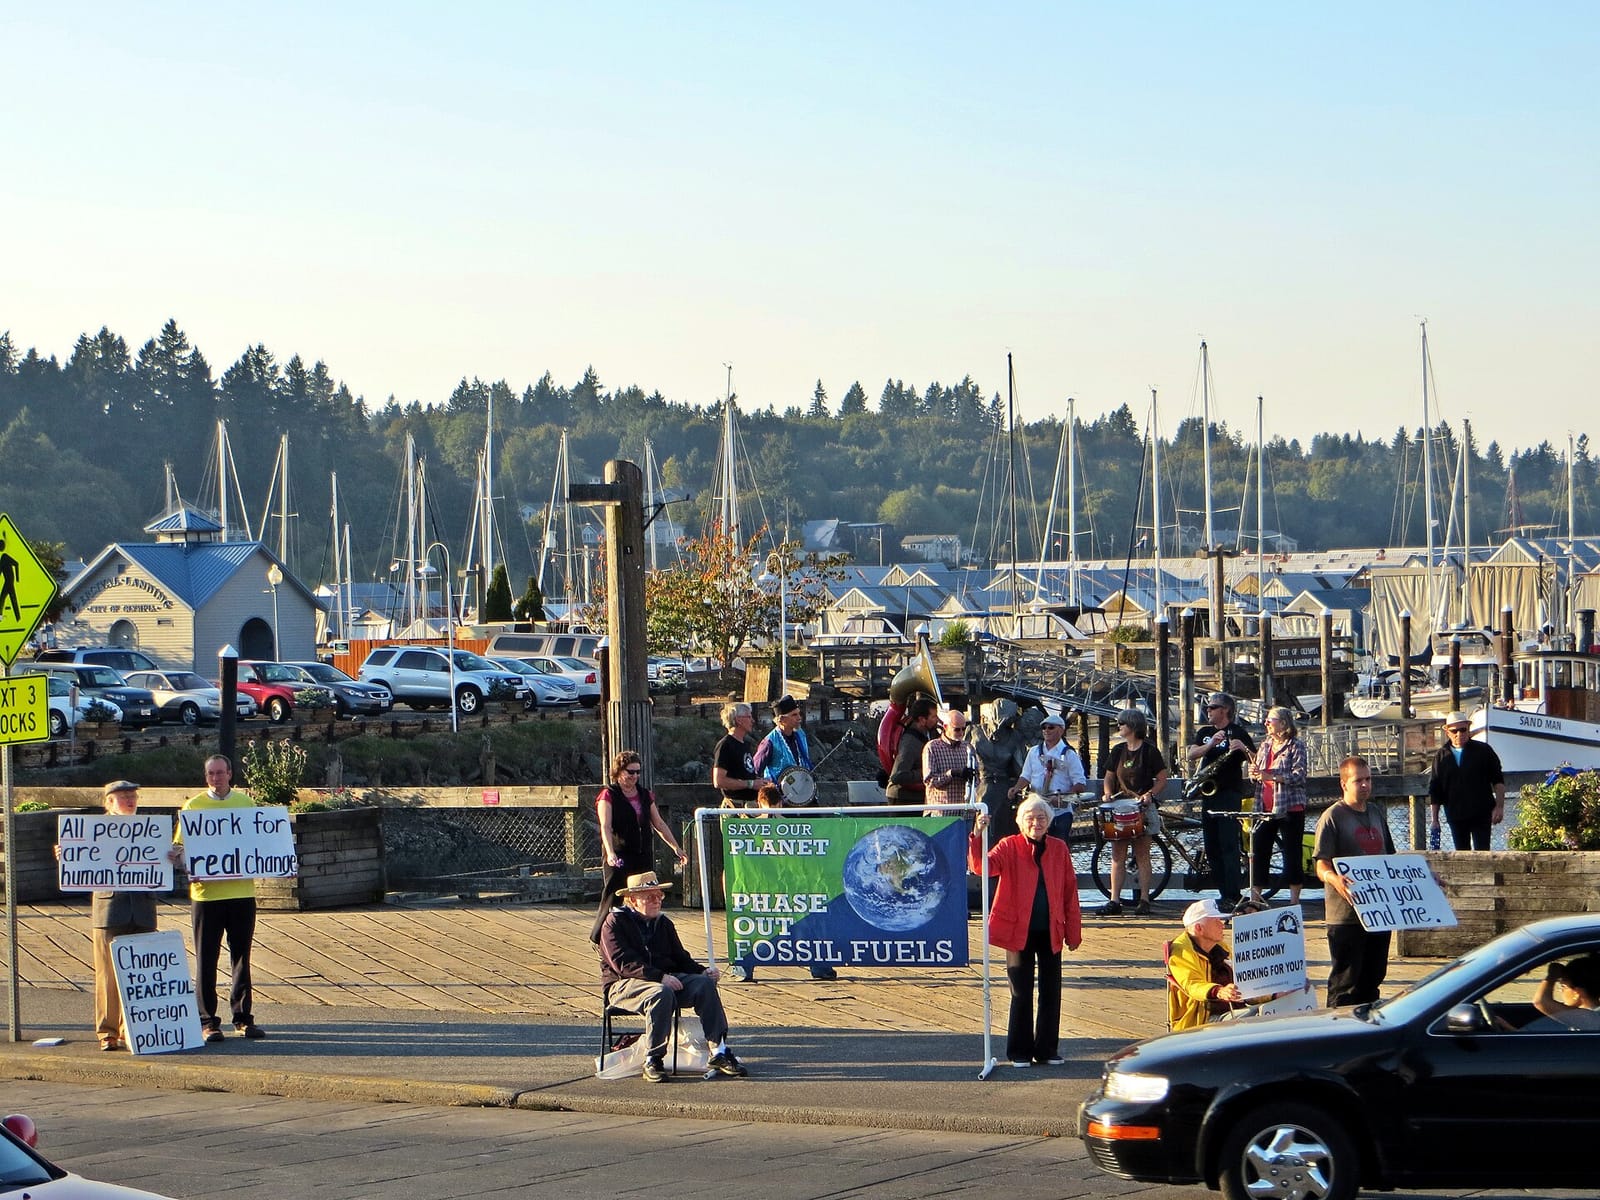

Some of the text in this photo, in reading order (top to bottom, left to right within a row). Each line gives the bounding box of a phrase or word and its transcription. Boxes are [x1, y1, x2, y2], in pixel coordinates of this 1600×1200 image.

[1, 685, 36, 708] XT 3
[1, 712, 36, 735] OCKS
[1519, 715, 1562, 731] SAND MAN
[61, 817, 162, 843] All people
[182, 811, 286, 837] Work for
[728, 823, 812, 836] SAVE OUR
[63, 845, 159, 863] are one
[729, 838, 829, 855] PLANET
[190, 848, 297, 876] real change
[1337, 860, 1426, 883] Peace begins
[61, 864, 164, 889] human family
[731, 893, 828, 913] PHASE
[1351, 883, 1424, 906] with you
[733, 916, 794, 936] OUT
[1360, 904, 1441, 928] and me.
[1235, 926, 1273, 944] HOW IS THE
[117, 945, 180, 970] Change
[734, 939, 954, 963] FOSSIL FUELS
[1235, 943, 1285, 963] WAR ECONOMY
[127, 971, 163, 984] to a
[1235, 959, 1304, 983] WORKING FOR YOU?
[126, 980, 195, 1001] PEACEFUL
[130, 1003, 189, 1023] foreign
[136, 1023, 185, 1053] policy
